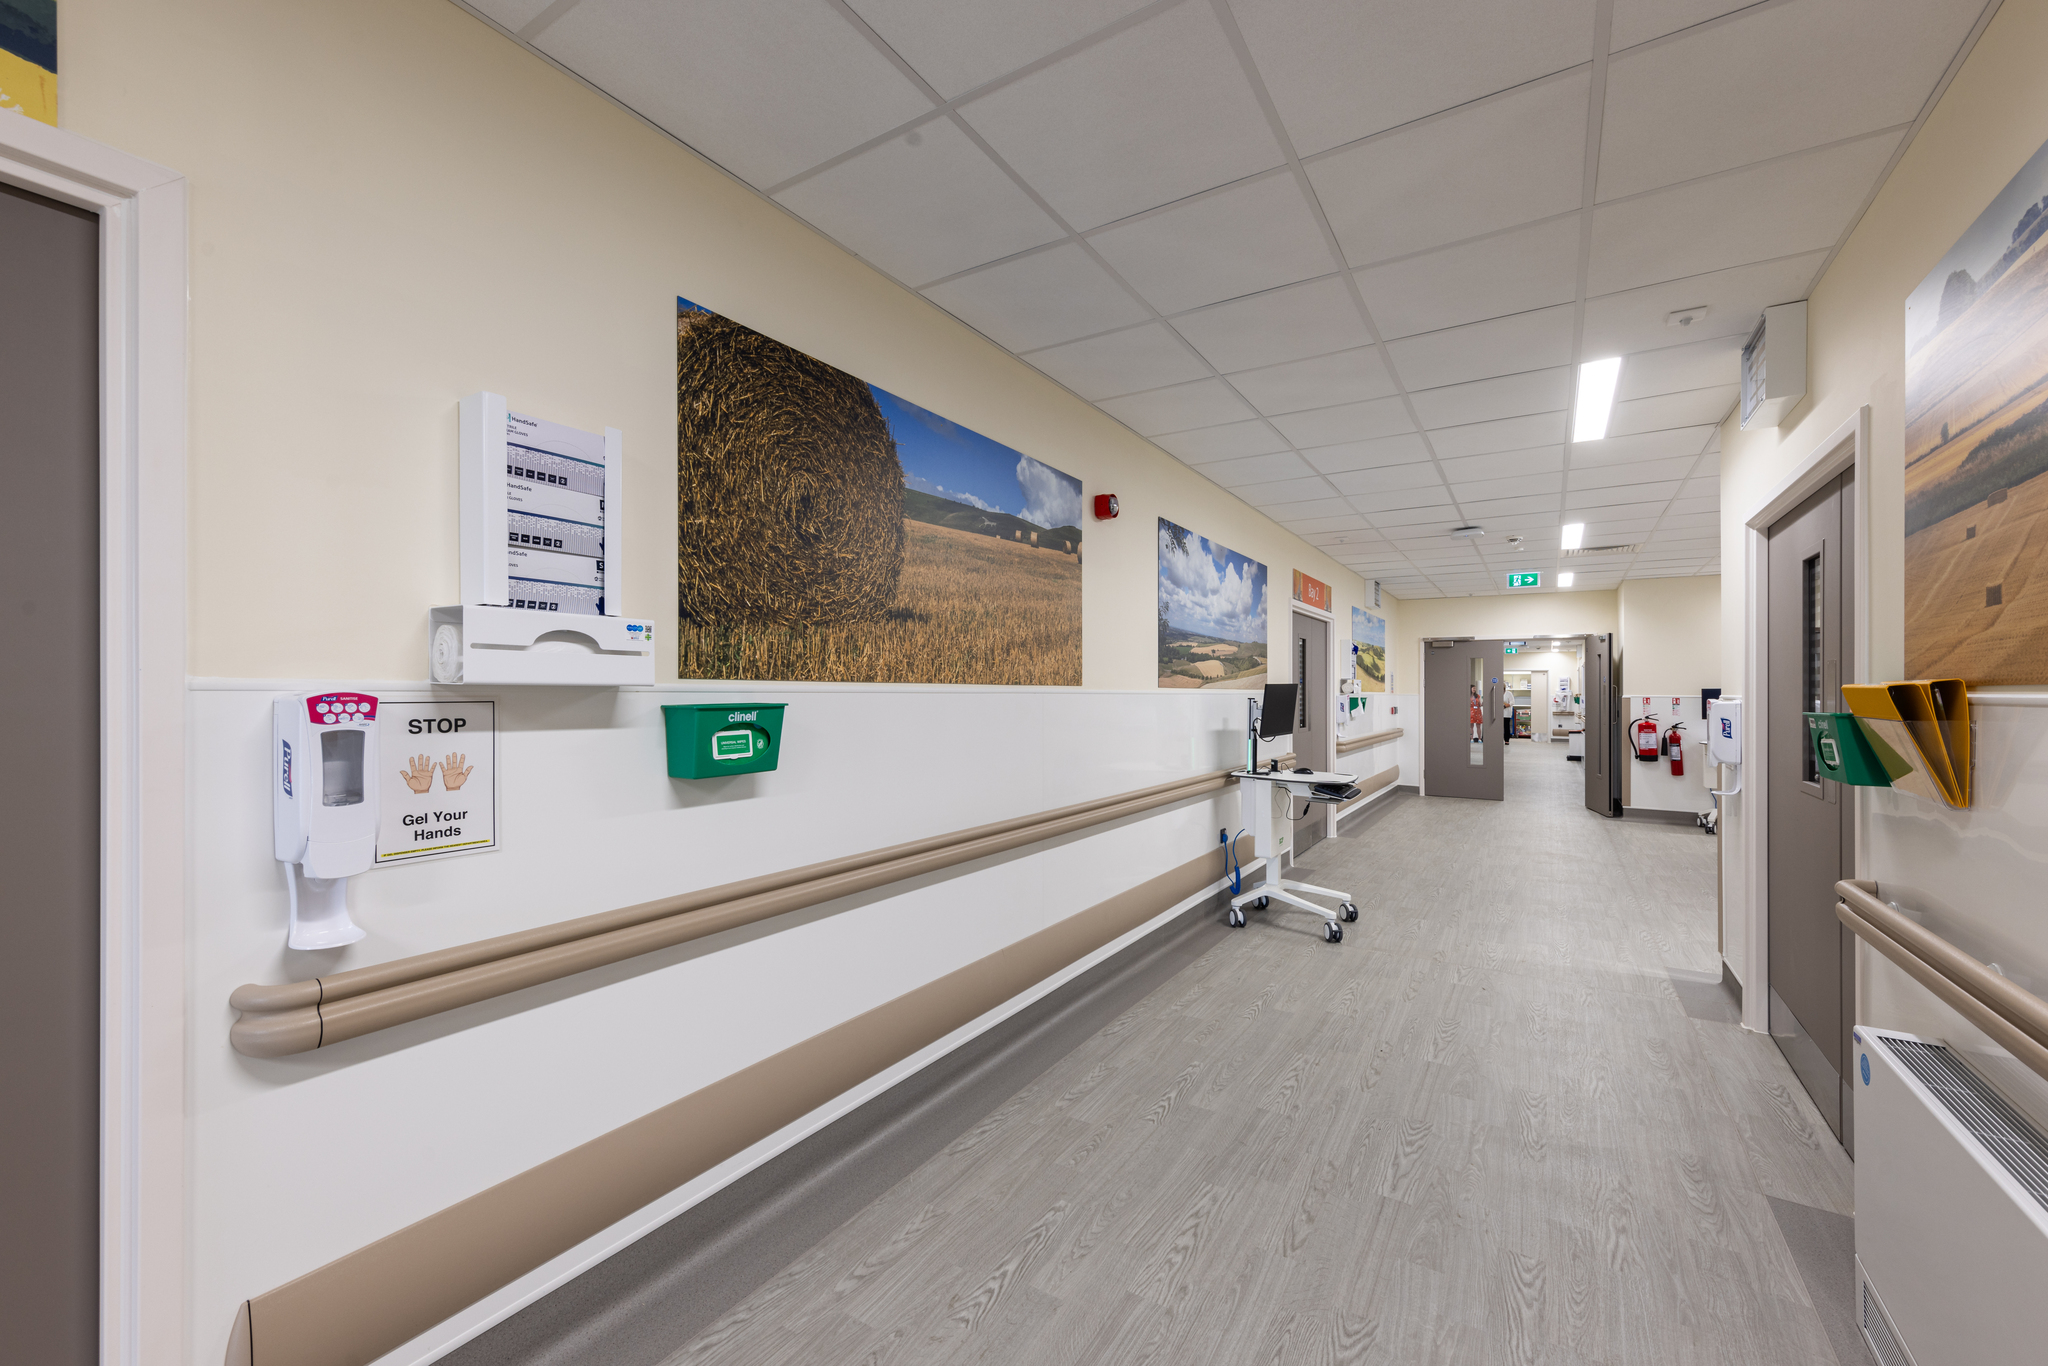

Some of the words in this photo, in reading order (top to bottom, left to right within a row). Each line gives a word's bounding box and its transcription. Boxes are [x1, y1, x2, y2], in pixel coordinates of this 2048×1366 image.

[511, 416, 538, 428] HandSafe
[507, 482, 532, 492] HandSafe
[1308, 583, 1316, 602] Bay
[728, 712, 757, 722] clinell
[408, 718, 466, 734] STOP
[402, 813, 428, 826] Gel
[433, 811, 468, 822] Your
[414, 826, 462, 841] Hands
